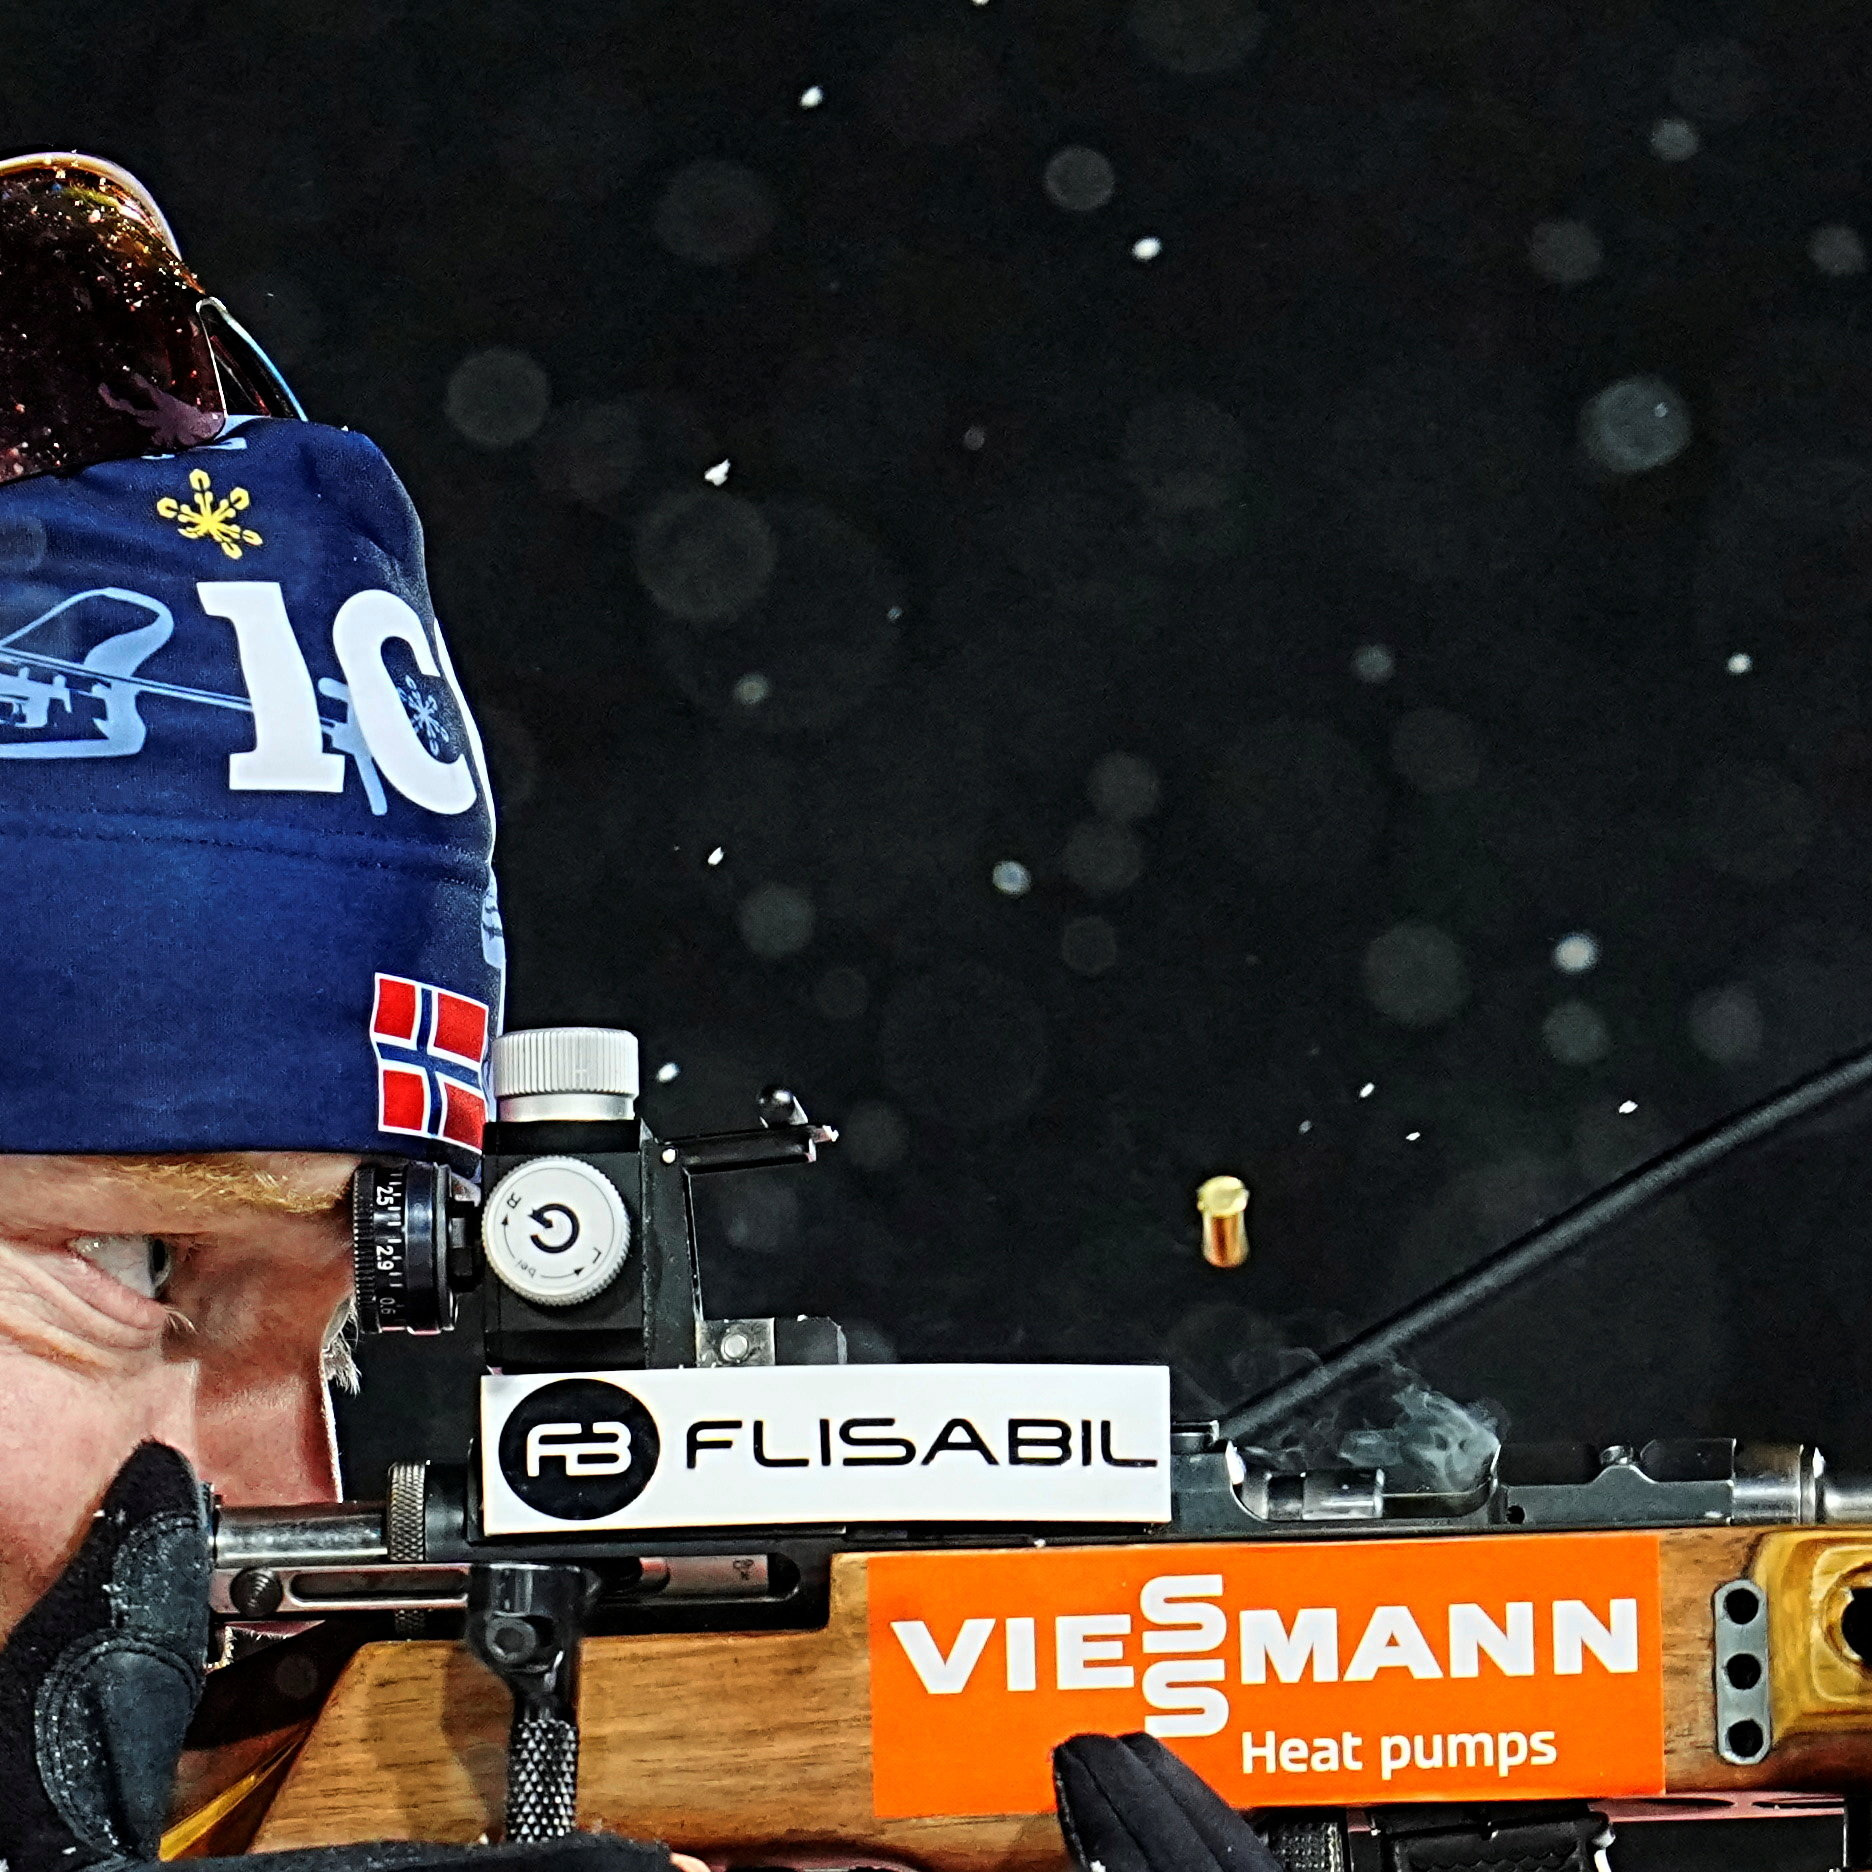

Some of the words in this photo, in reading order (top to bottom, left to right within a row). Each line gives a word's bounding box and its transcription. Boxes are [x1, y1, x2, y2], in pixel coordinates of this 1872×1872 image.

[196, 581, 496, 815] ic
[686, 1418, 1157, 1470] FLISABIL
[890, 1573, 1639, 1738] VIESSMANN
[1242, 1730, 1363, 1775] Heat
[1381, 1729, 1558, 1780] pumps
